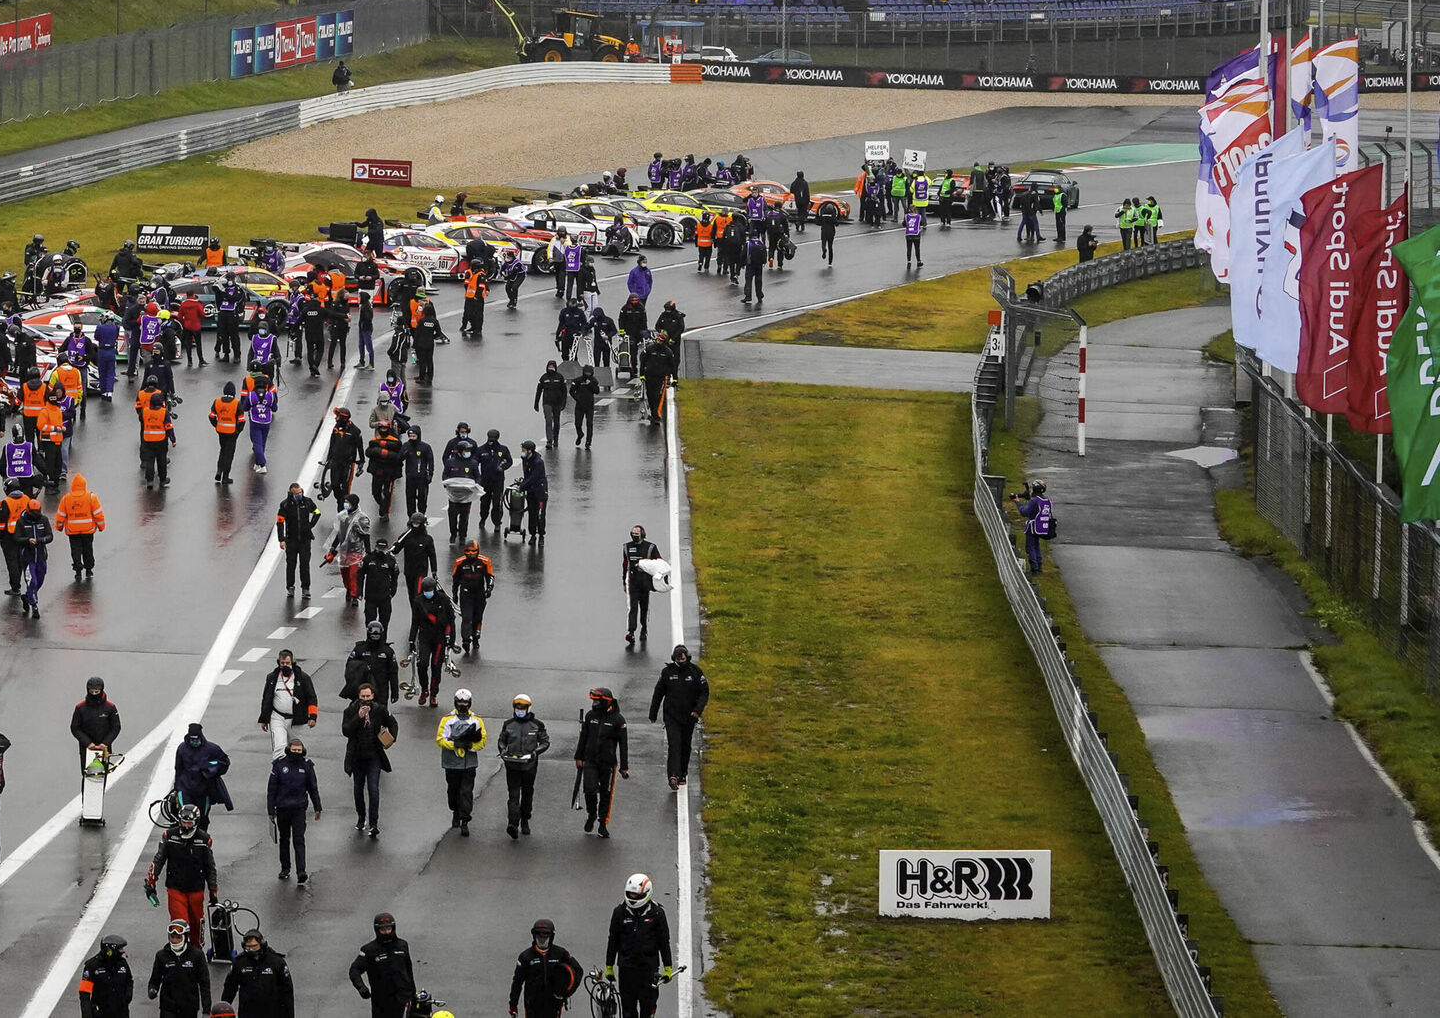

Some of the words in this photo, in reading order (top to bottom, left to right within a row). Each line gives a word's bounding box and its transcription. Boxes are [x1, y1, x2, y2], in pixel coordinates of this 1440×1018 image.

[282, 35, 295, 53] TOTAL
[302, 32, 315, 49] TOTAL
[701, 66, 750, 77] OKOHAMA
[785, 69, 843, 81] YOKOHAMA
[886, 73, 944, 86] YOKOHAMA
[978, 76, 1033, 88] YOKOHAMA
[1066, 78, 1117, 89] YOKOHAMA
[1364, 76, 1404, 87] YOKOHAMA
[1149, 80, 1200, 91] YOKOHAMA
[912, 152, 918, 162] 3
[370, 167, 407, 177] TOTAL
[138, 235, 163, 245] GRAN
[165, 236, 204, 246] TURISMO
[897, 858, 987, 900] H&R
[897, 901, 921, 909] Das
[925, 901, 988, 909] Fahrwerk!
